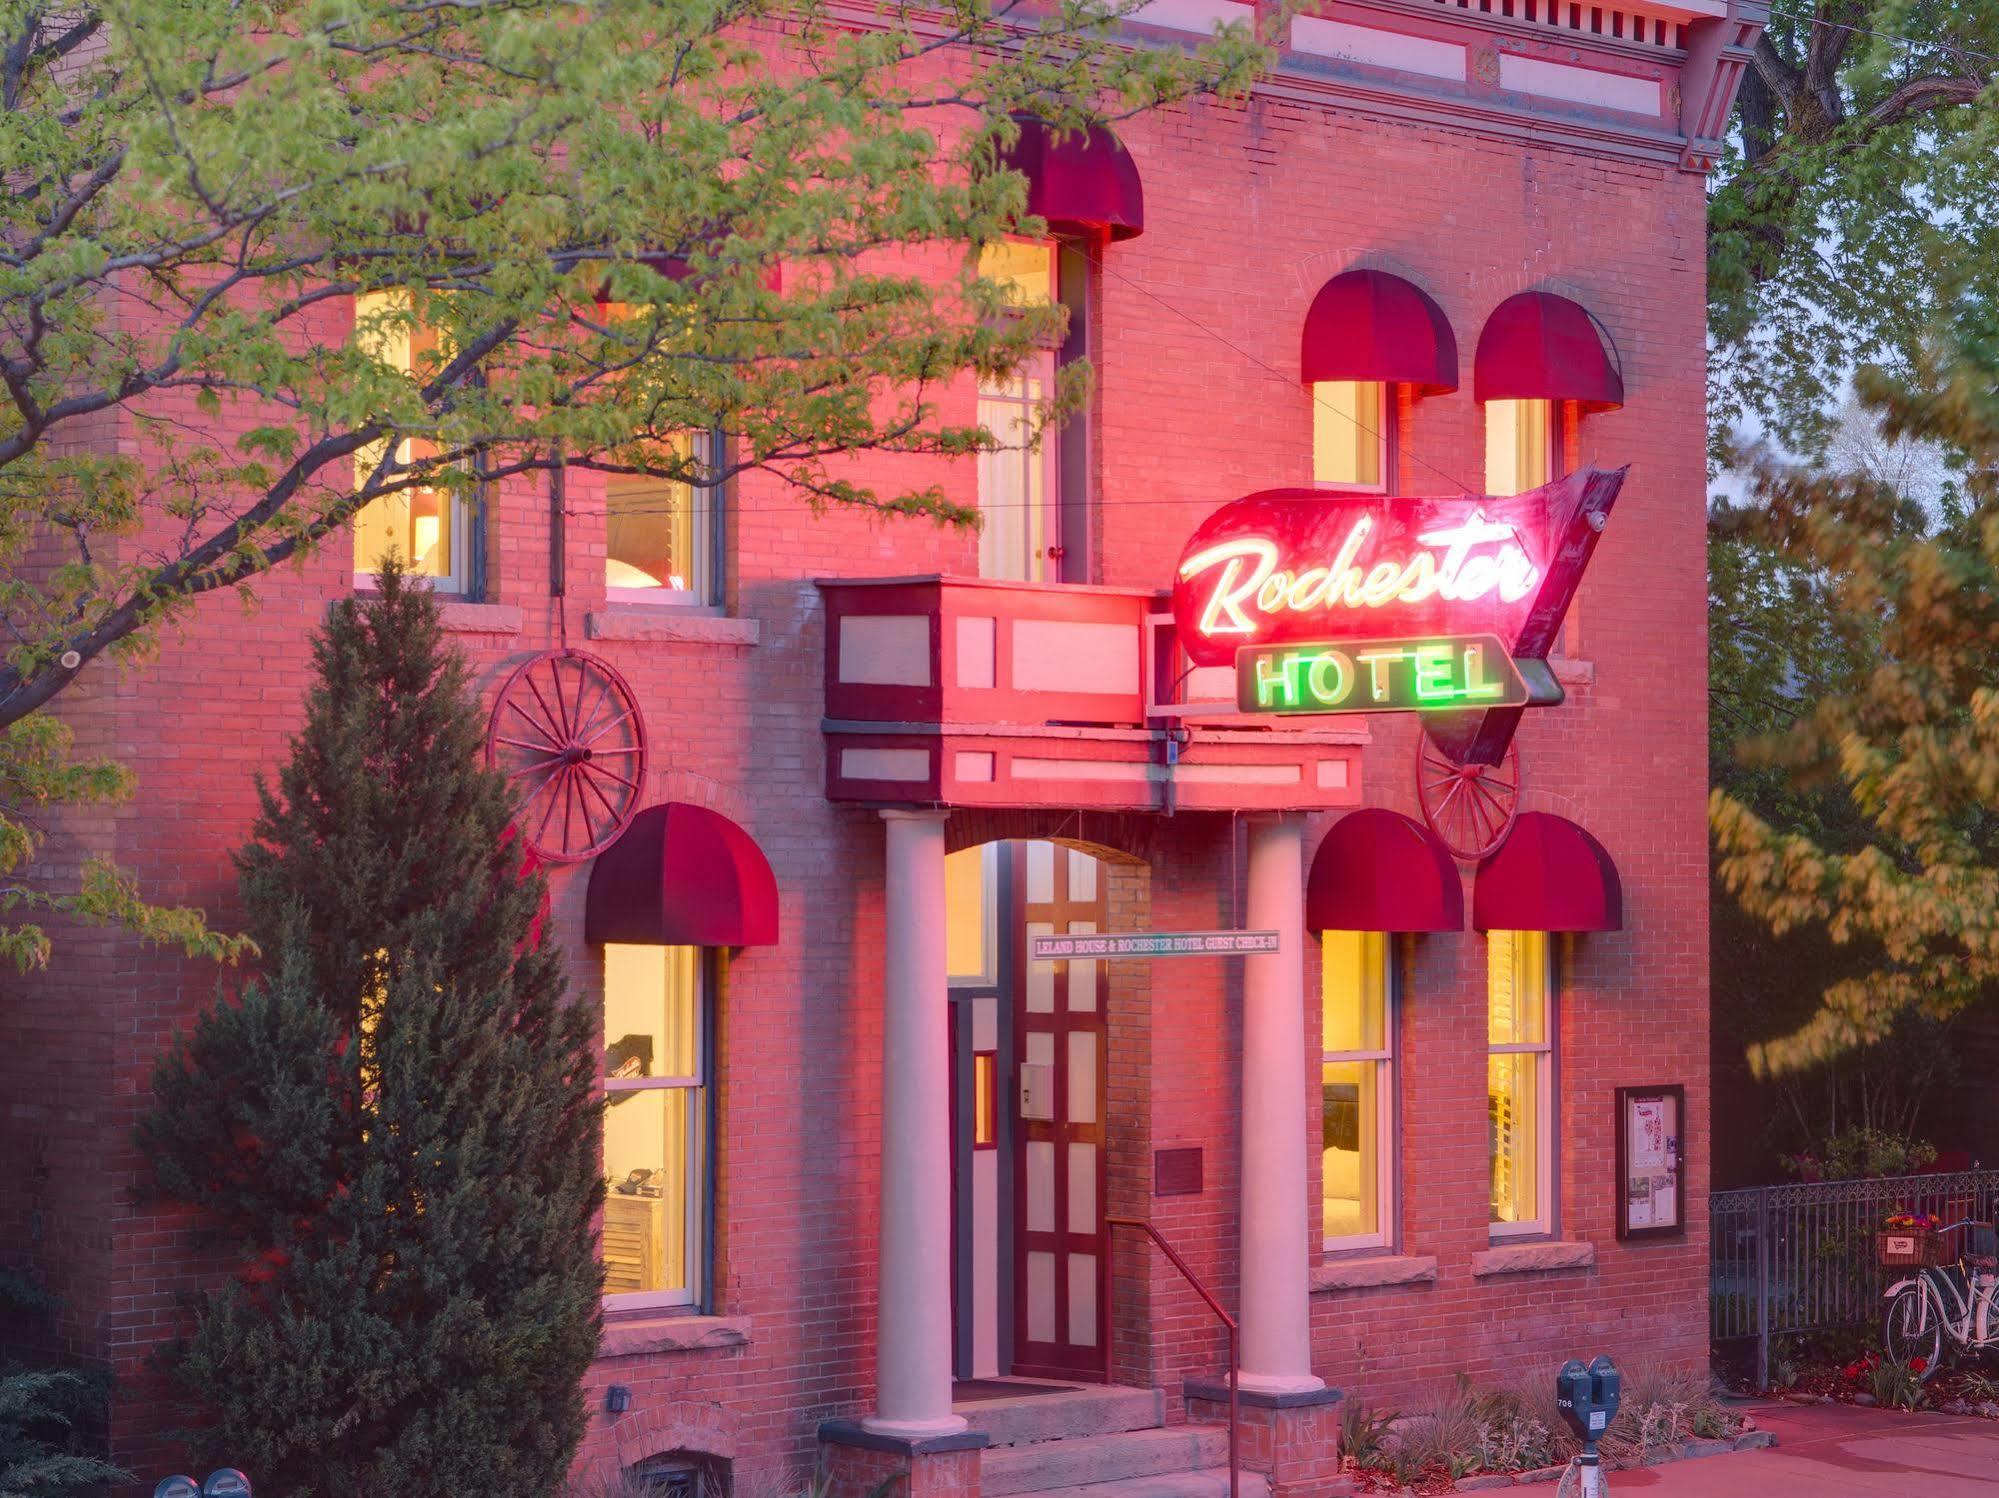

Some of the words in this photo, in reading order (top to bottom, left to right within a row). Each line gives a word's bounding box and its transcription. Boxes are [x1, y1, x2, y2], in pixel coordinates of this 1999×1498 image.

[1179, 508, 1540, 637] Rochester
[1256, 645, 1504, 708] HOTEL
[1036, 940, 1073, 954] LELAND
[1075, 939, 1107, 953] HOUSE
[1108, 939, 1117, 952] &
[1118, 937, 1172, 952] ROCHESTER
[1174, 937, 1204, 951] HOTEL
[1205, 936, 1235, 950] GUEST
[1236, 935, 1277, 949] CHECK-IN
